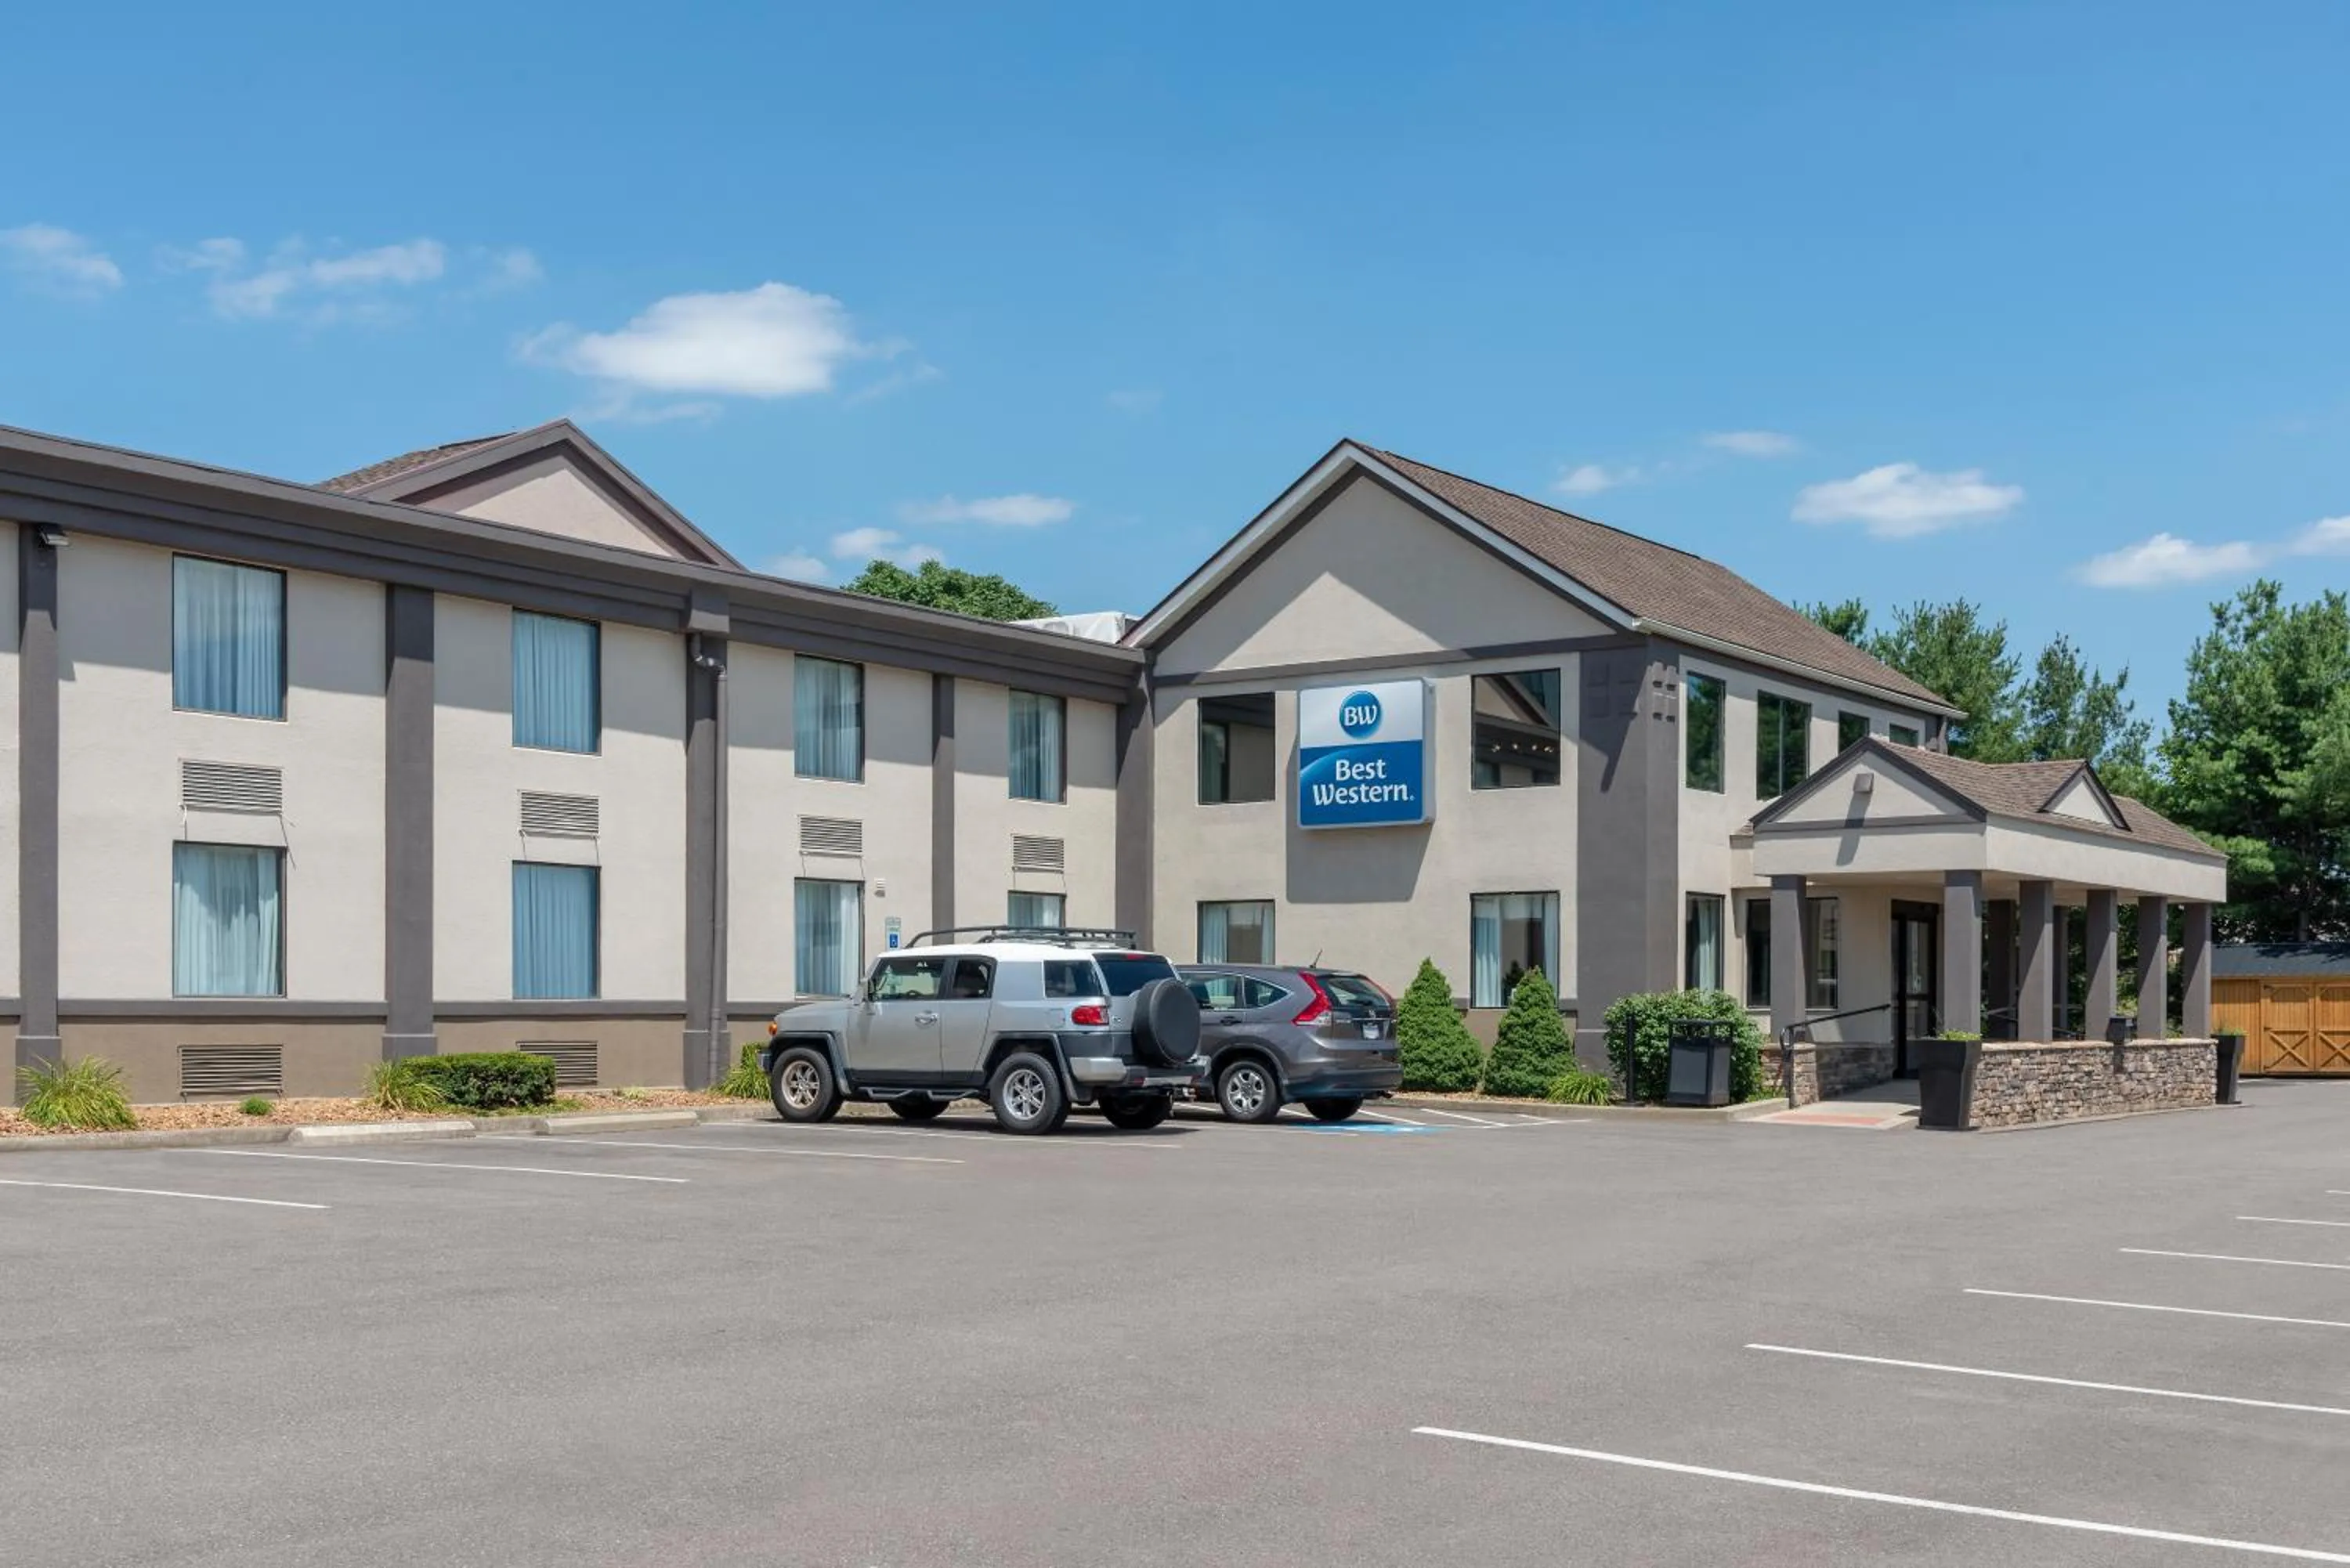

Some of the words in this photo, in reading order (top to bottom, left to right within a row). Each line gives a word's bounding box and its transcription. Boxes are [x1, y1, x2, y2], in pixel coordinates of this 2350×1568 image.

[1344, 705, 1376, 726] BW
[1336, 759, 1386, 781] Best
[1313, 783, 1408, 806] Western
